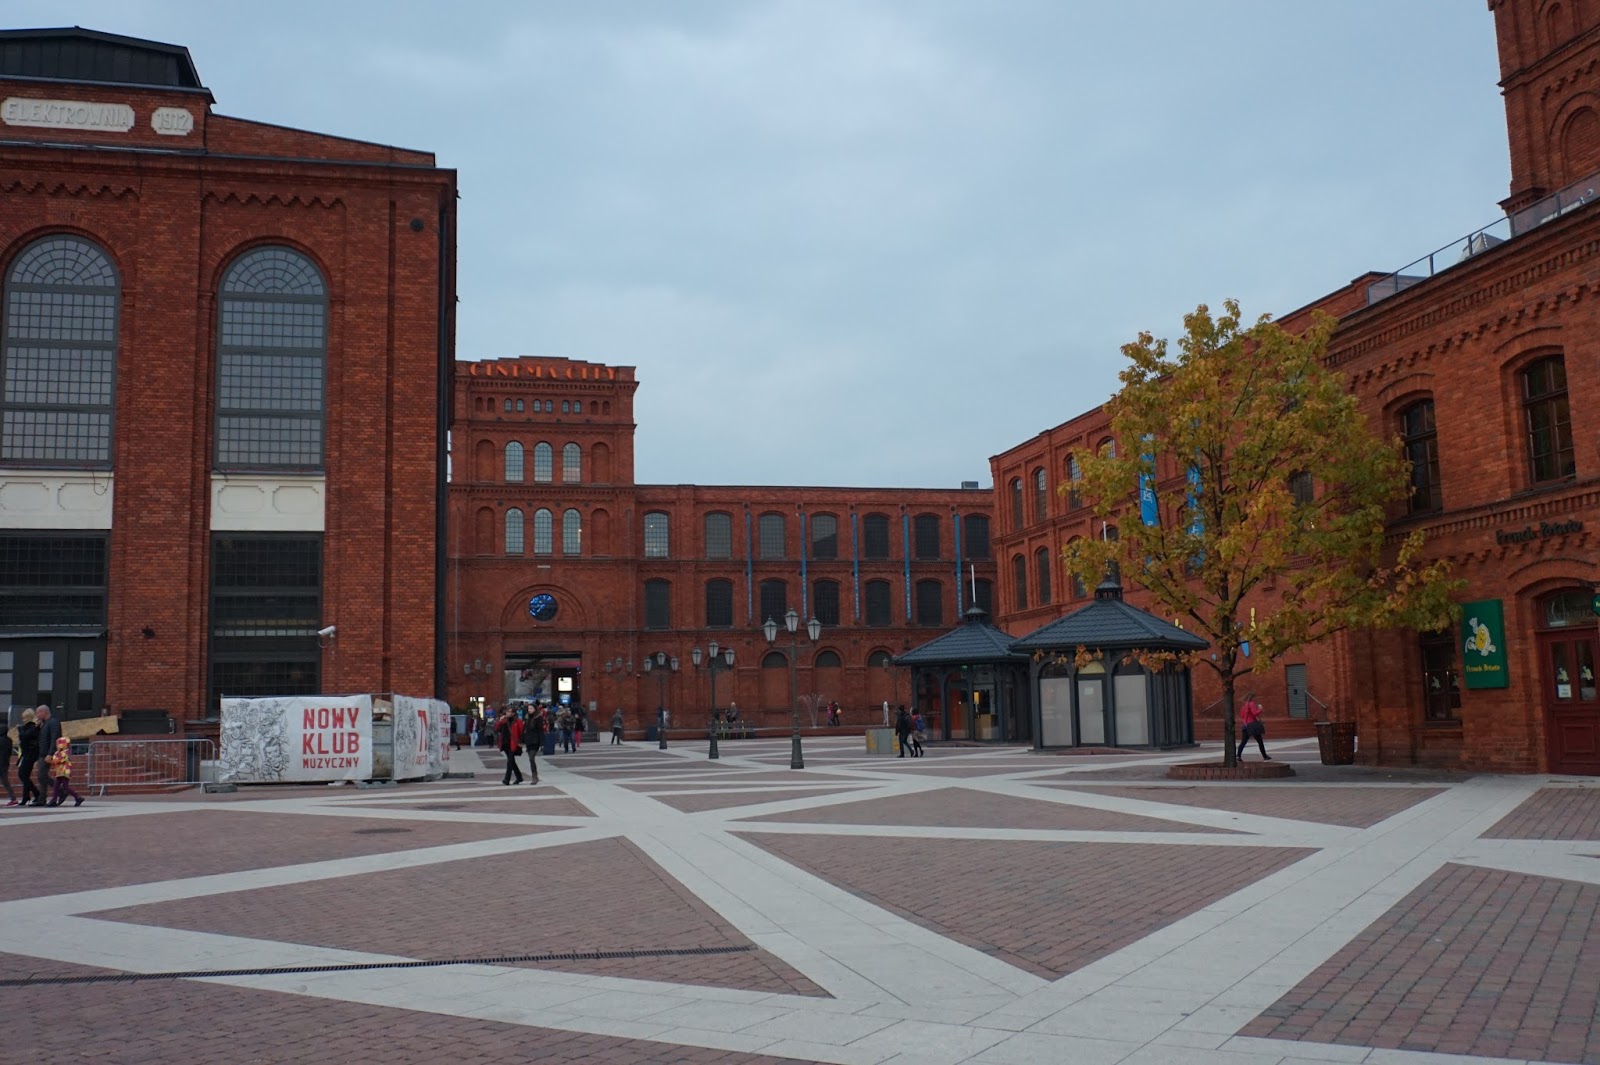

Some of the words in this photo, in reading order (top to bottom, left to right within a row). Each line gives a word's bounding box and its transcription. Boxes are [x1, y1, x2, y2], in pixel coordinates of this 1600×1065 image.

[6, 103, 131, 128] ELEKTROWNIA
[157, 112, 189, 131] 1912
[469, 363, 558, 378] CINEMA
[566, 366, 616, 380] CITY
[303, 707, 360, 729] NOWY
[303, 732, 360, 754] KLUB
[302, 757, 359, 769] MUZYCZNY
